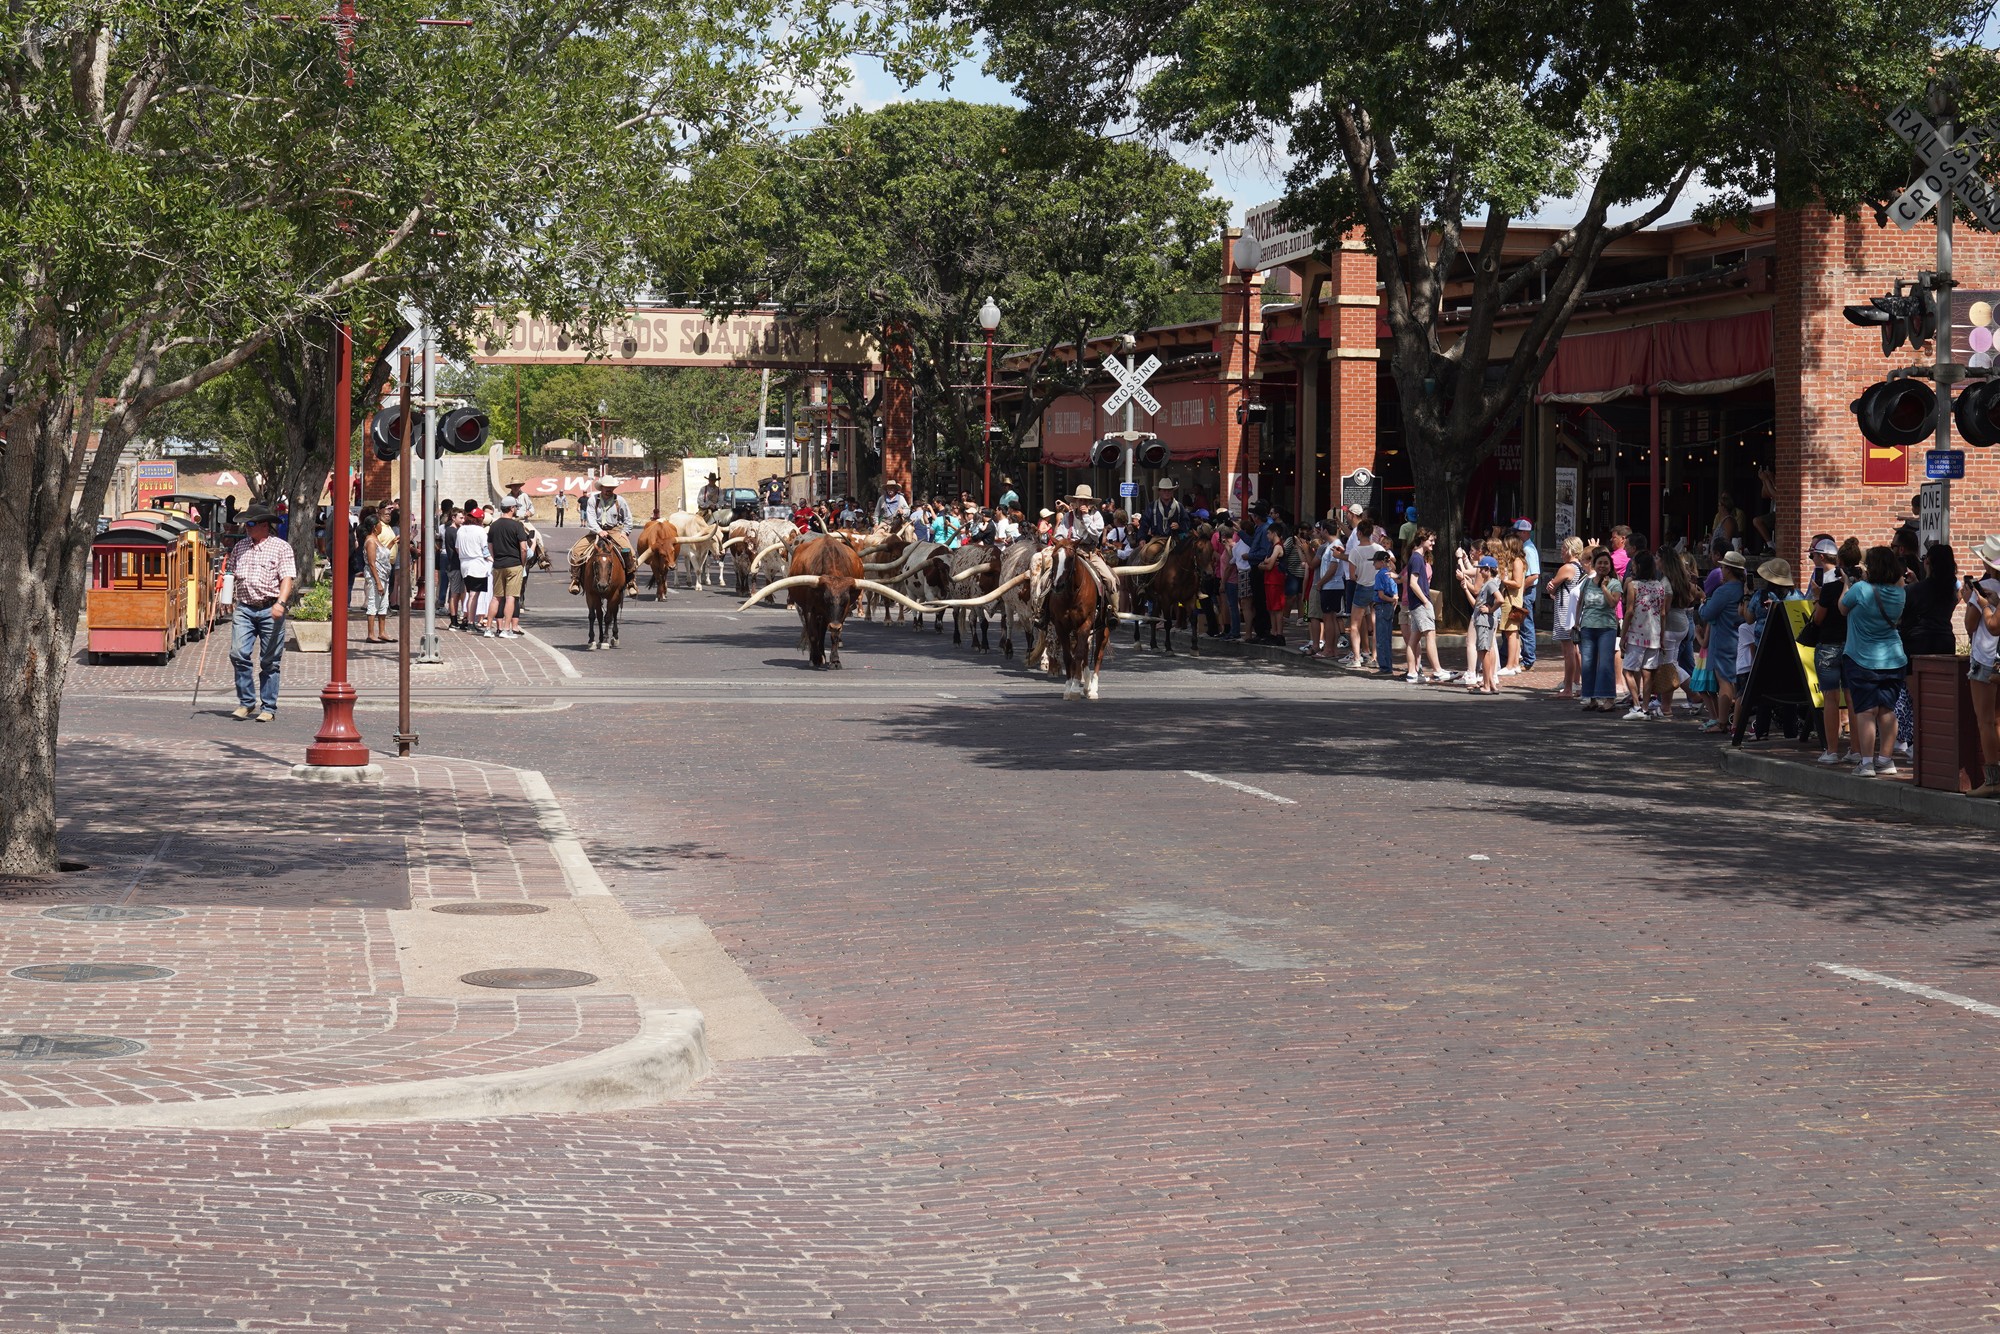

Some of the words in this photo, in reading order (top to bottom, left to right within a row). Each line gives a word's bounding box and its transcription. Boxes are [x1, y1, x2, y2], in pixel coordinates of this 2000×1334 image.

[1892, 106, 1938, 159] RAIL
[1288, 235, 1302, 254] AND
[679, 318, 802, 356] STATION
[1105, 357, 1126, 382] RAIL
[1135, 388, 1158, 413] ROAD
[1107, 359, 1156, 410] CROSSING
[139, 481, 173, 491] PETTING
[1922, 490, 1940, 509] ONE
[1922, 512, 1940, 530] WAY
